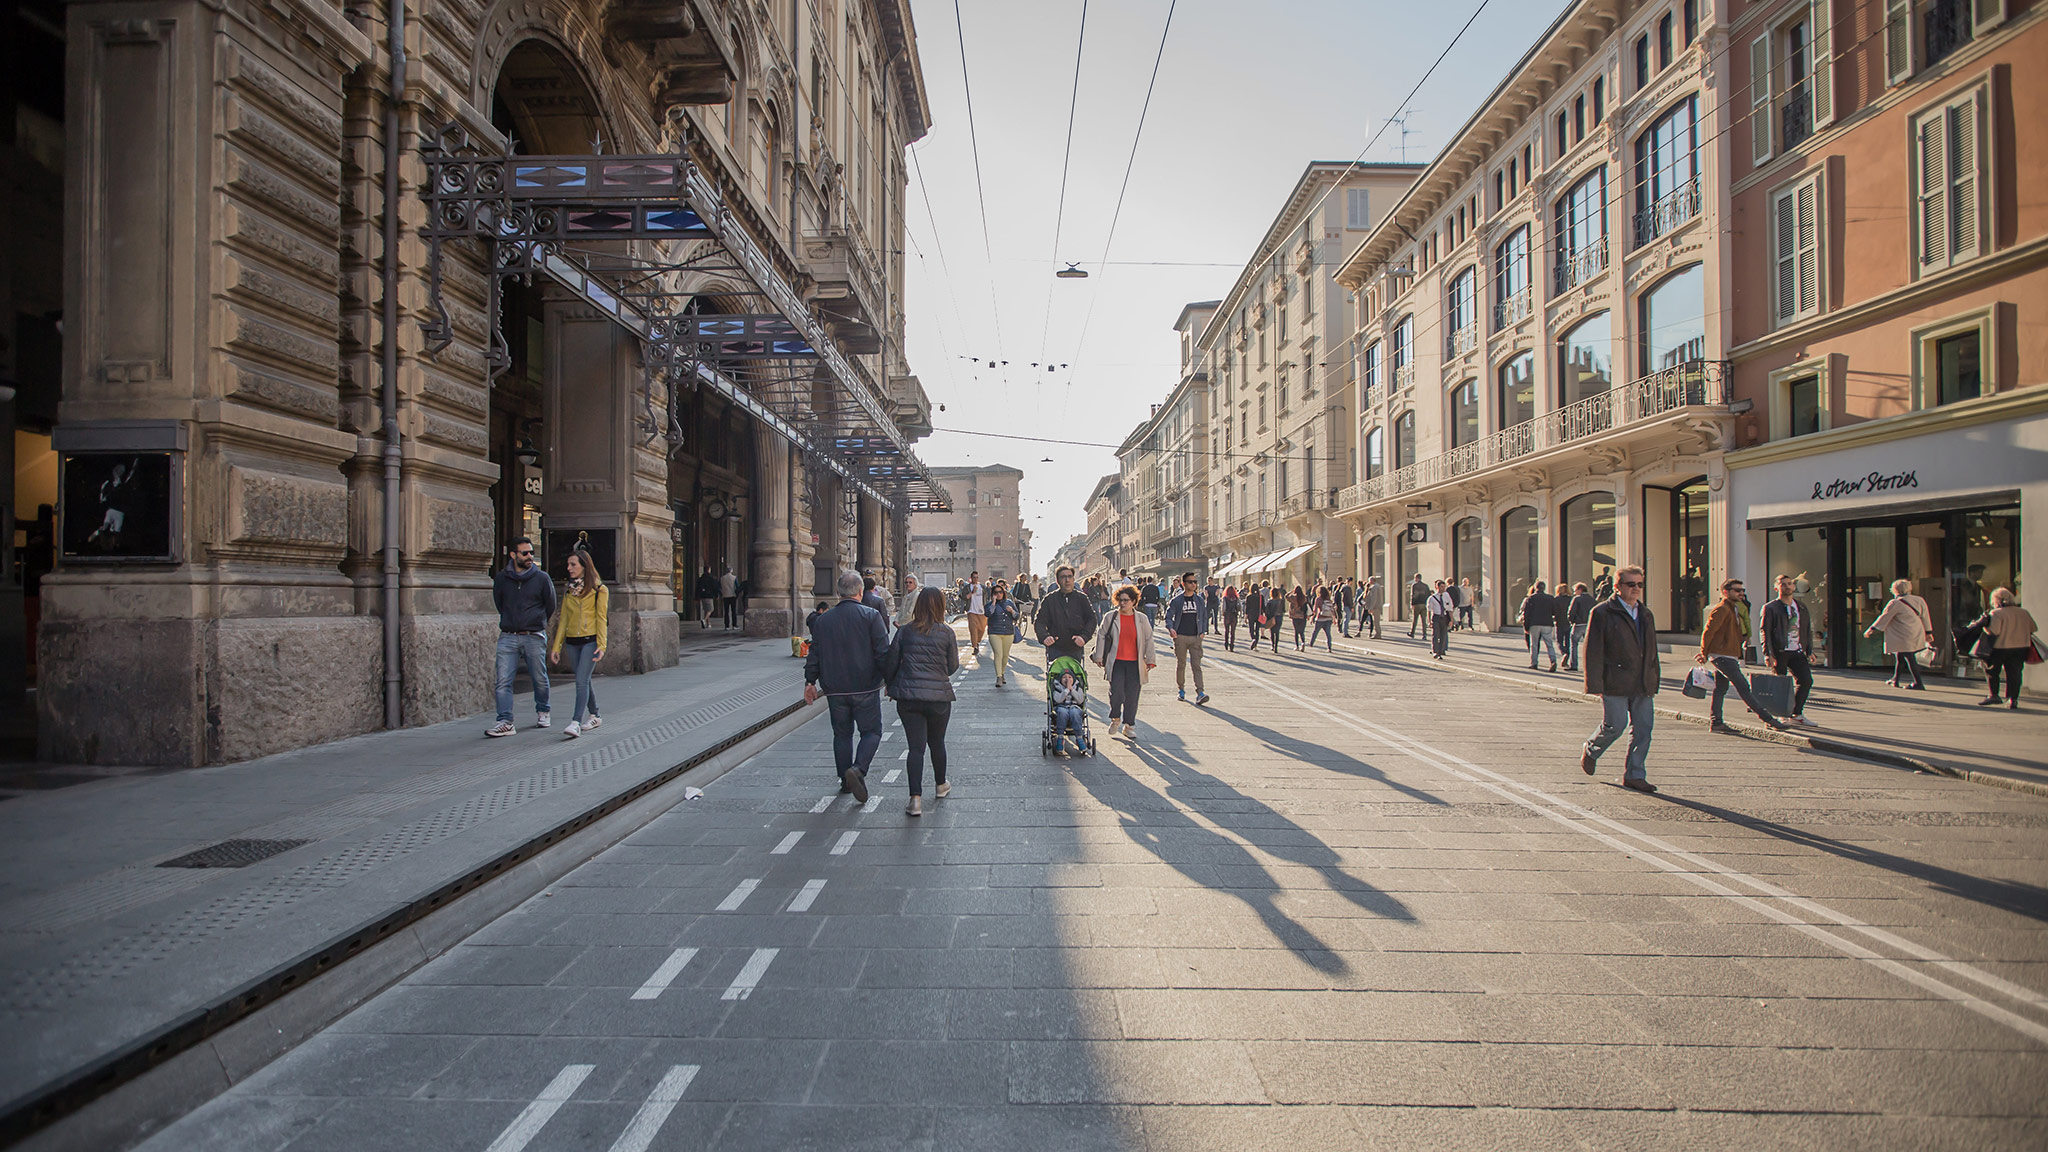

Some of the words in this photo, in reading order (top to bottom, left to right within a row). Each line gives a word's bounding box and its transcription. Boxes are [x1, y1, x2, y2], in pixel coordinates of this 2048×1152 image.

[1811, 481, 1825, 500] &
[1825, 478, 1866, 499] other
[1867, 471, 1918, 493] Stories
